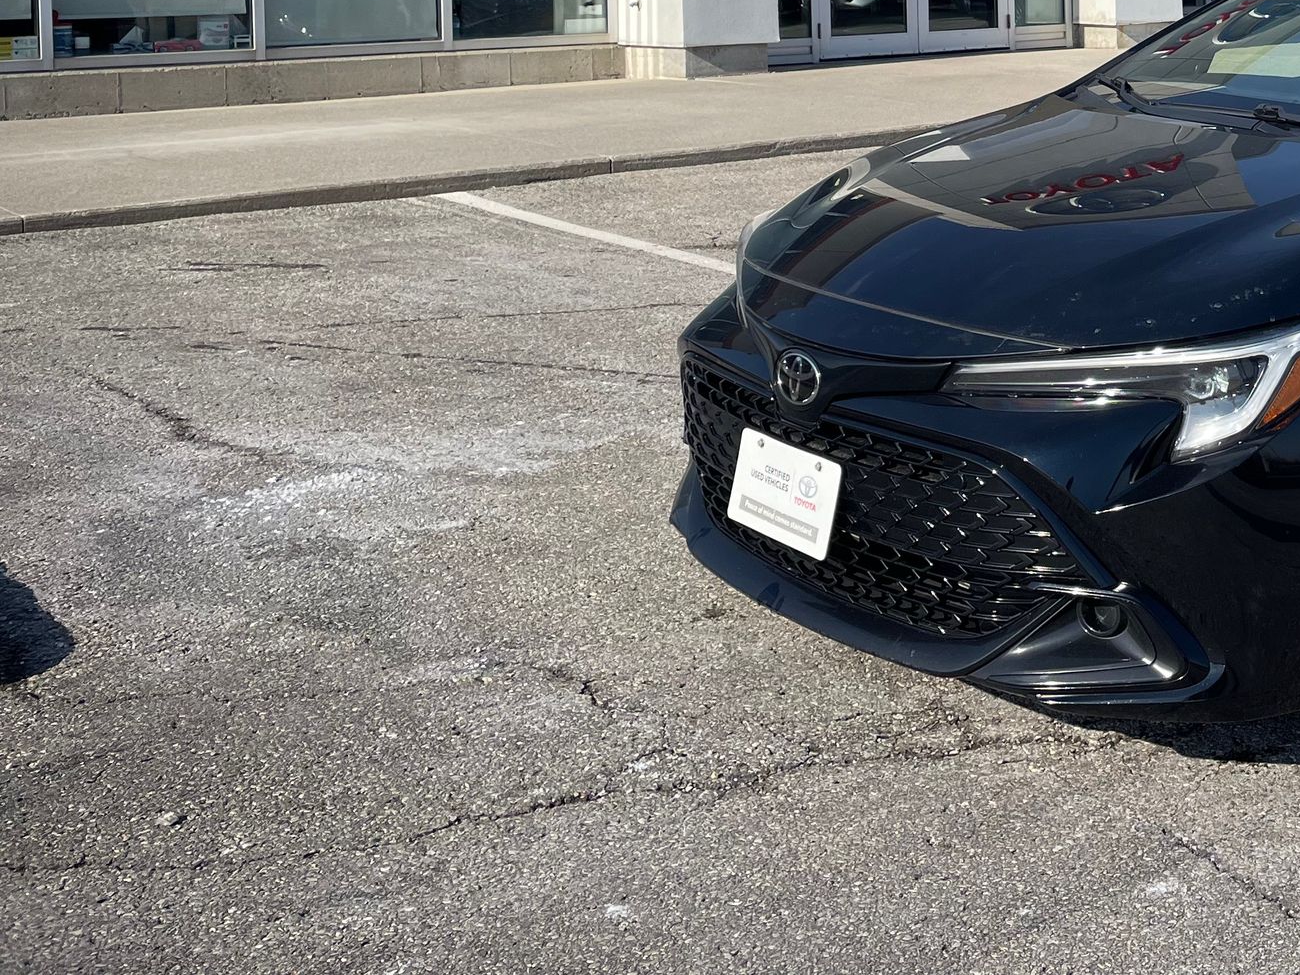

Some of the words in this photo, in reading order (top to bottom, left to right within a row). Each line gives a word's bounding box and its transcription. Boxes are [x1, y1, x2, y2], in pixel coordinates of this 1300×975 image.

[751, 468, 764, 481] USED
[765, 475, 789, 492] VEHICLES
[764, 464, 790, 482] CERTIFIED
[793, 496, 816, 512] TOYOTA
